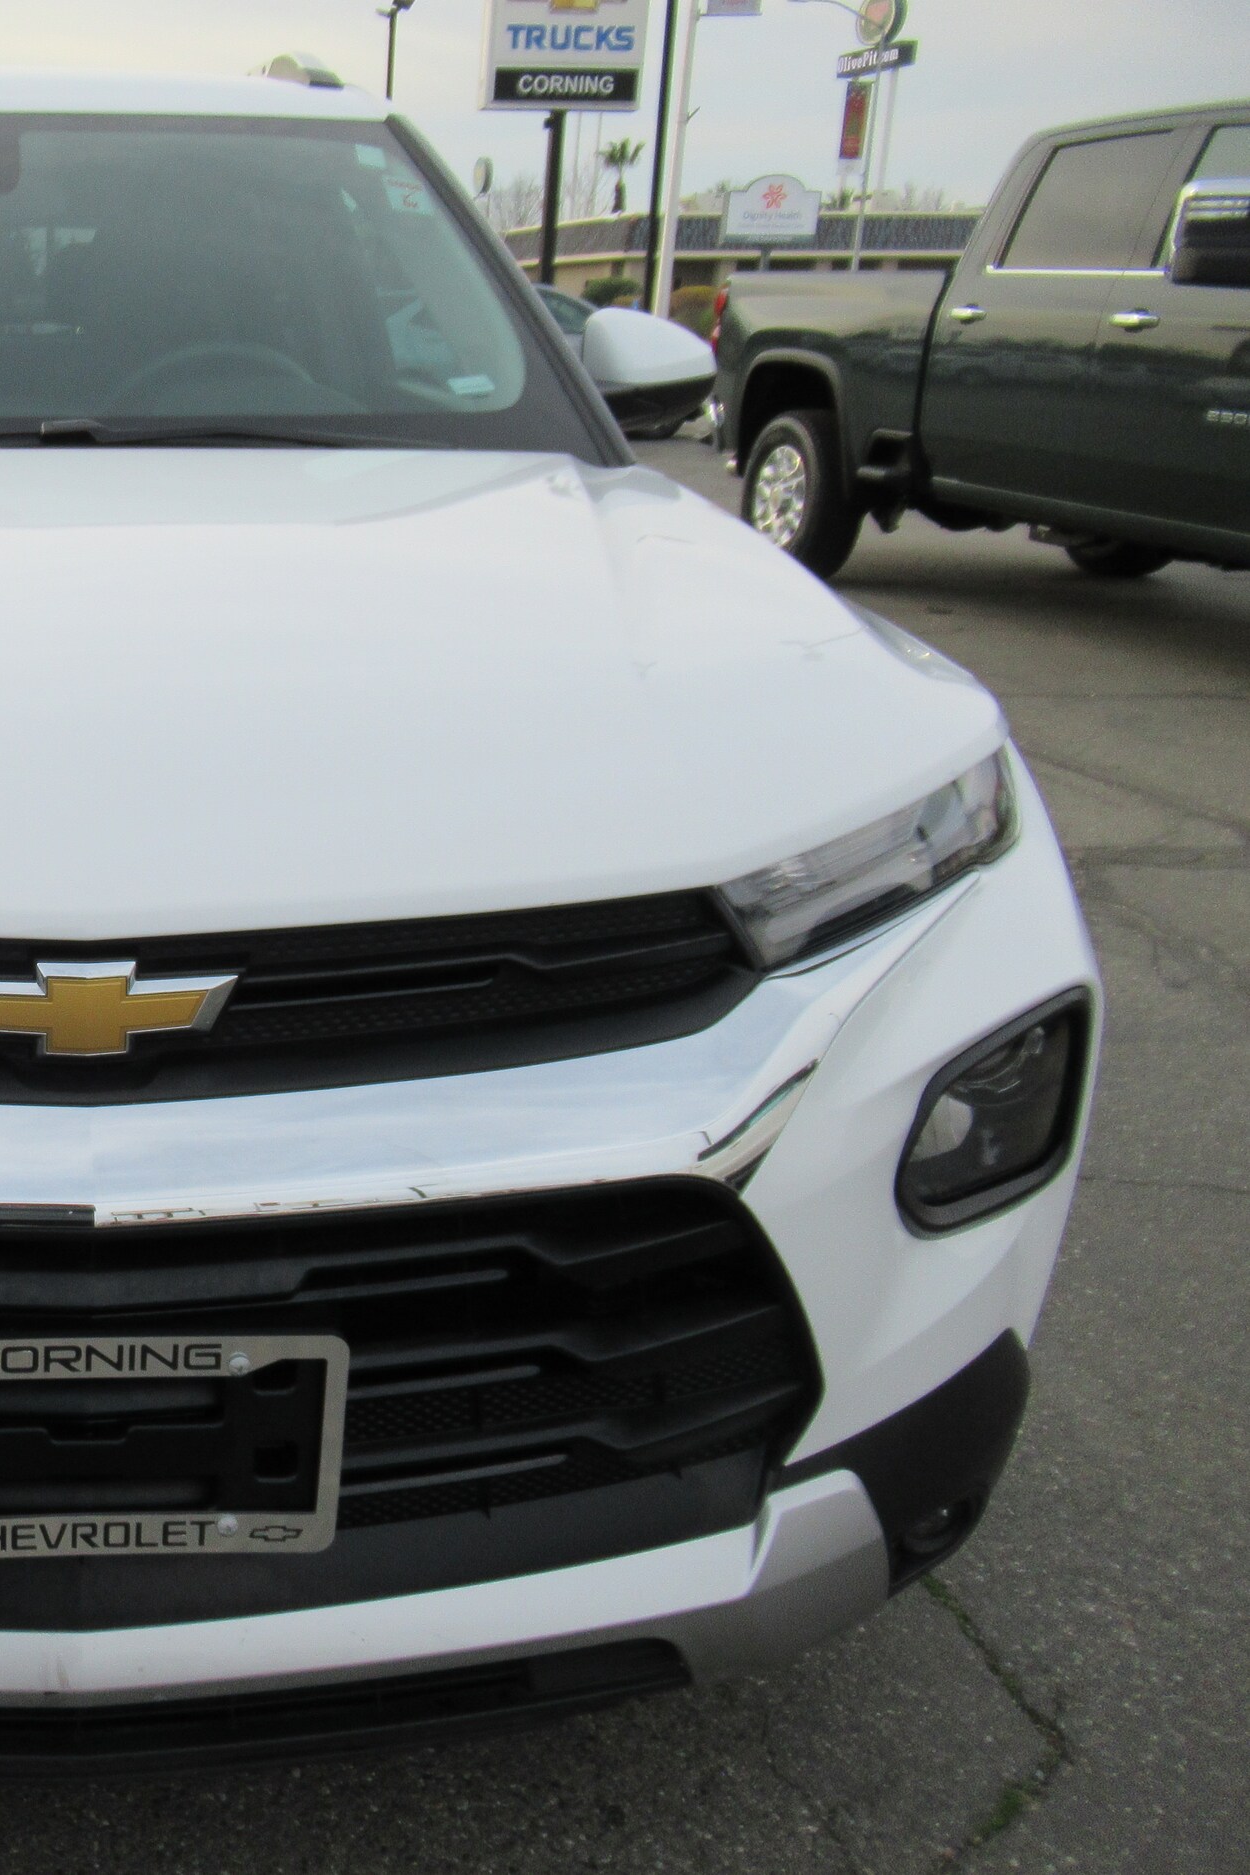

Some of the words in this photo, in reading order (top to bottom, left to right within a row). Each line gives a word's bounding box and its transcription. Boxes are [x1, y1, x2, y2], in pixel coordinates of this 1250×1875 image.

[507, 24, 636, 51] TRUCKS
[837, 48, 899, 74] OlivePitcom
[518, 74, 615, 94] CORNING
